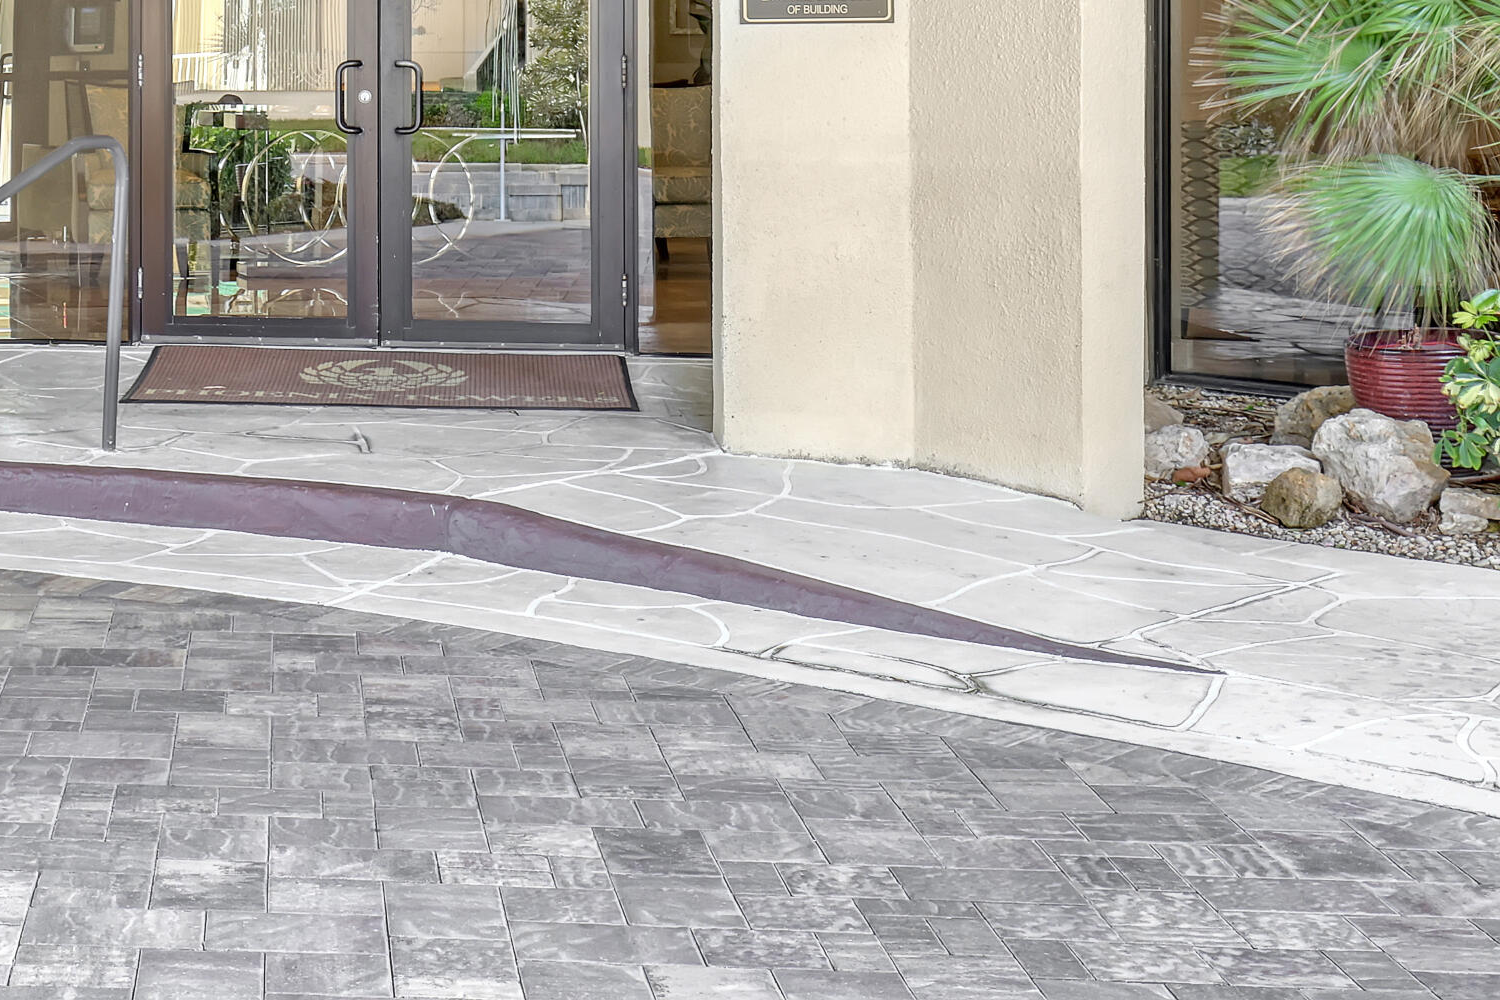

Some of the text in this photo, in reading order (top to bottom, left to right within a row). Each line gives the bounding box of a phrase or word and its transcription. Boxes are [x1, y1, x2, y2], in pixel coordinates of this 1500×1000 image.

[787, 4, 848, 15] OF BUILDING
[145, 388, 375, 400] PHOENIX
